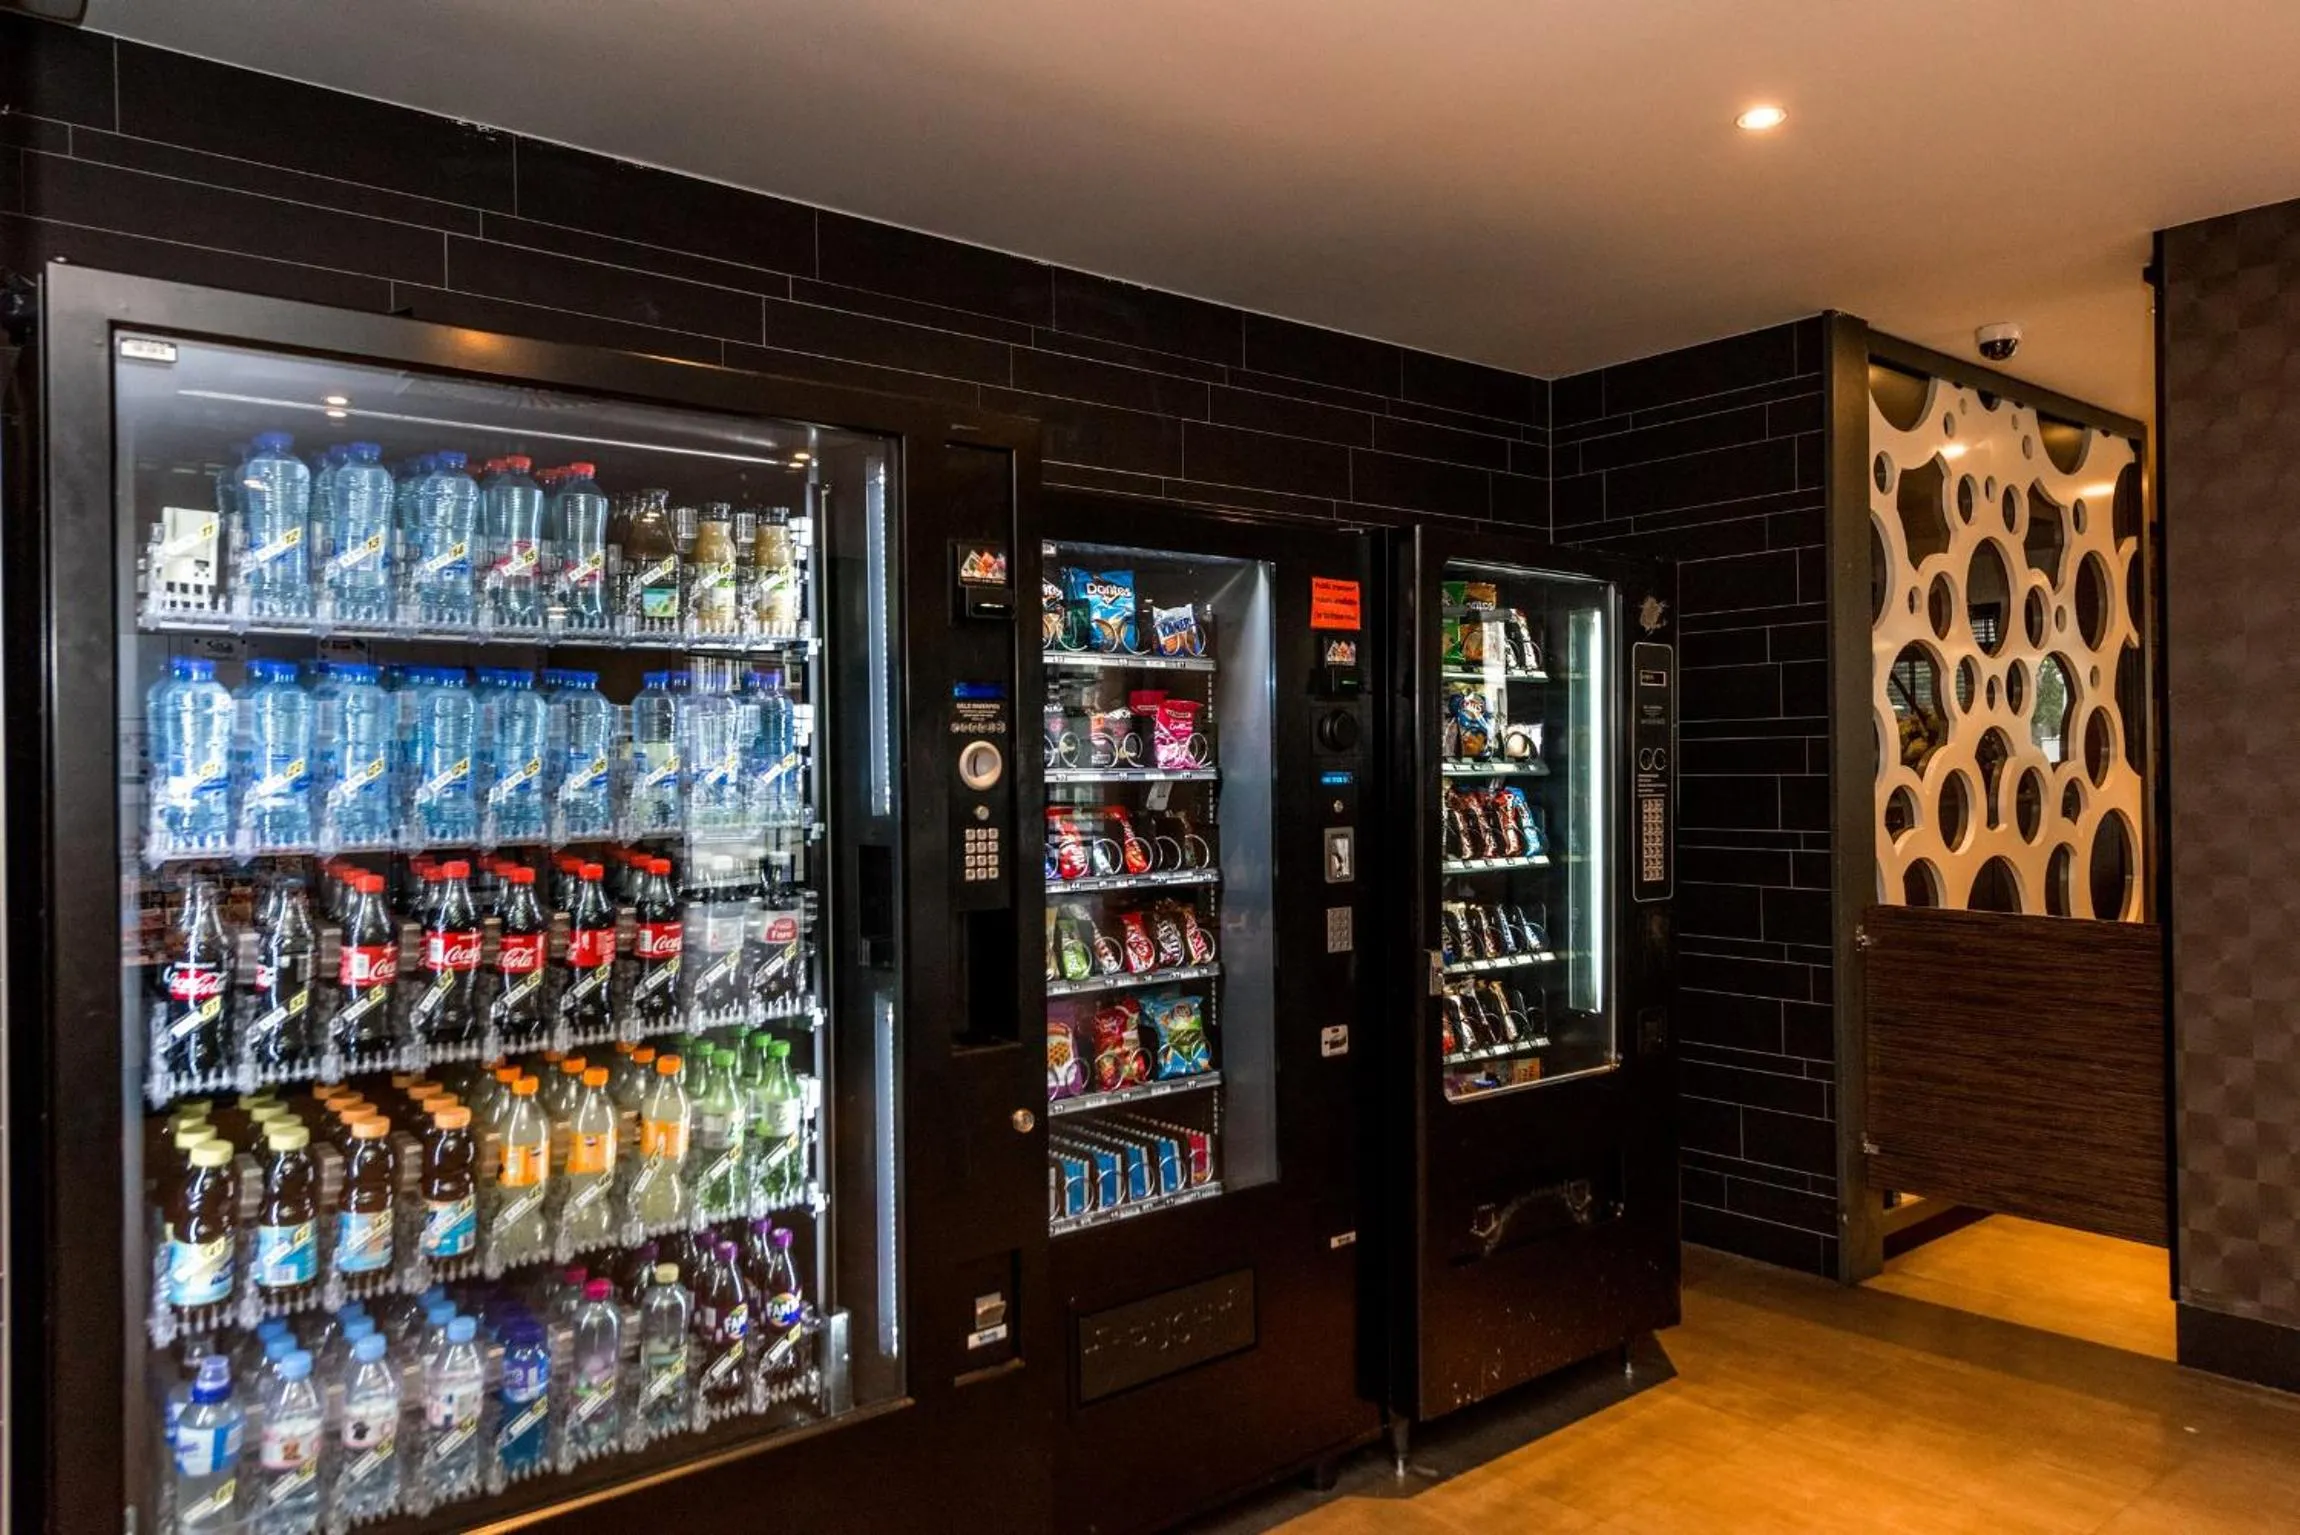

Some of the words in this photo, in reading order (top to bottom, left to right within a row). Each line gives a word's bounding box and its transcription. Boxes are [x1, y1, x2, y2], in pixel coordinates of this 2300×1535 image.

[286, 530, 298, 544] 12
[368, 536, 380, 550] 13
[1086, 582, 1133, 598] Doritos
[455, 759, 467, 775] 24
[502, 947, 537, 969] Cola
[723, 1313, 748, 1333] FAN
